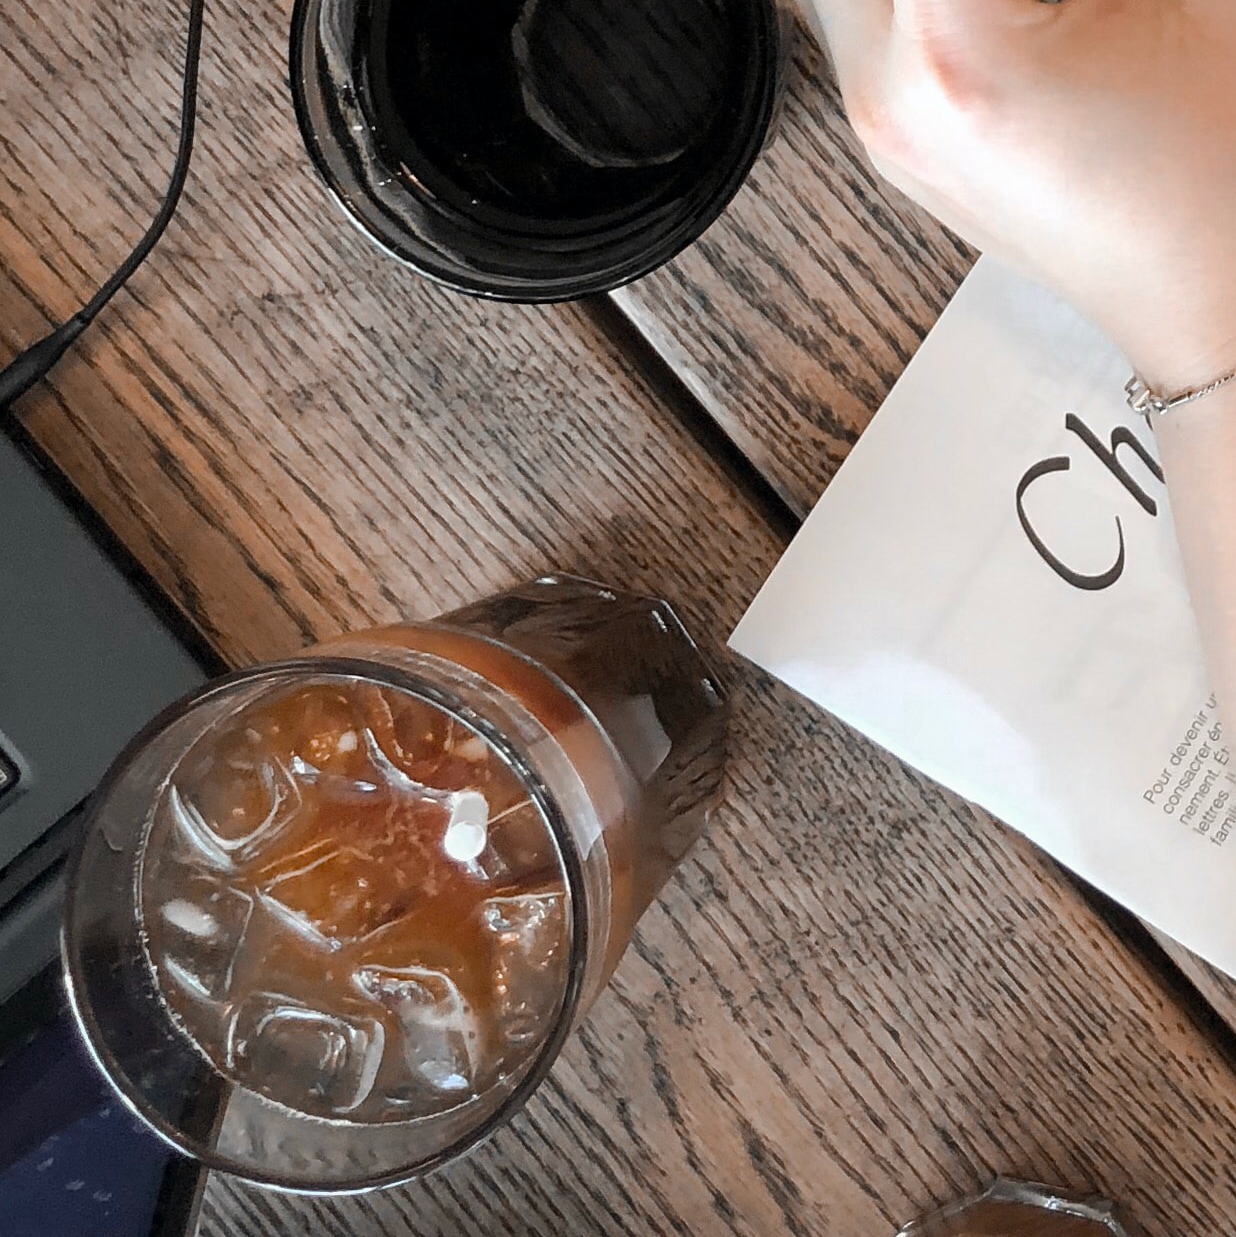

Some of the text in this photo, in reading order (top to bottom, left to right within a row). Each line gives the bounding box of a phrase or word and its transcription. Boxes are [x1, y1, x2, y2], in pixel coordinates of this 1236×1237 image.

[1016, 413, 1158, 591] Ch
[1142, 767, 1173, 805] Pour
[1169, 710, 1208, 767] devenir
[1162, 740, 1212, 815] consacrer
